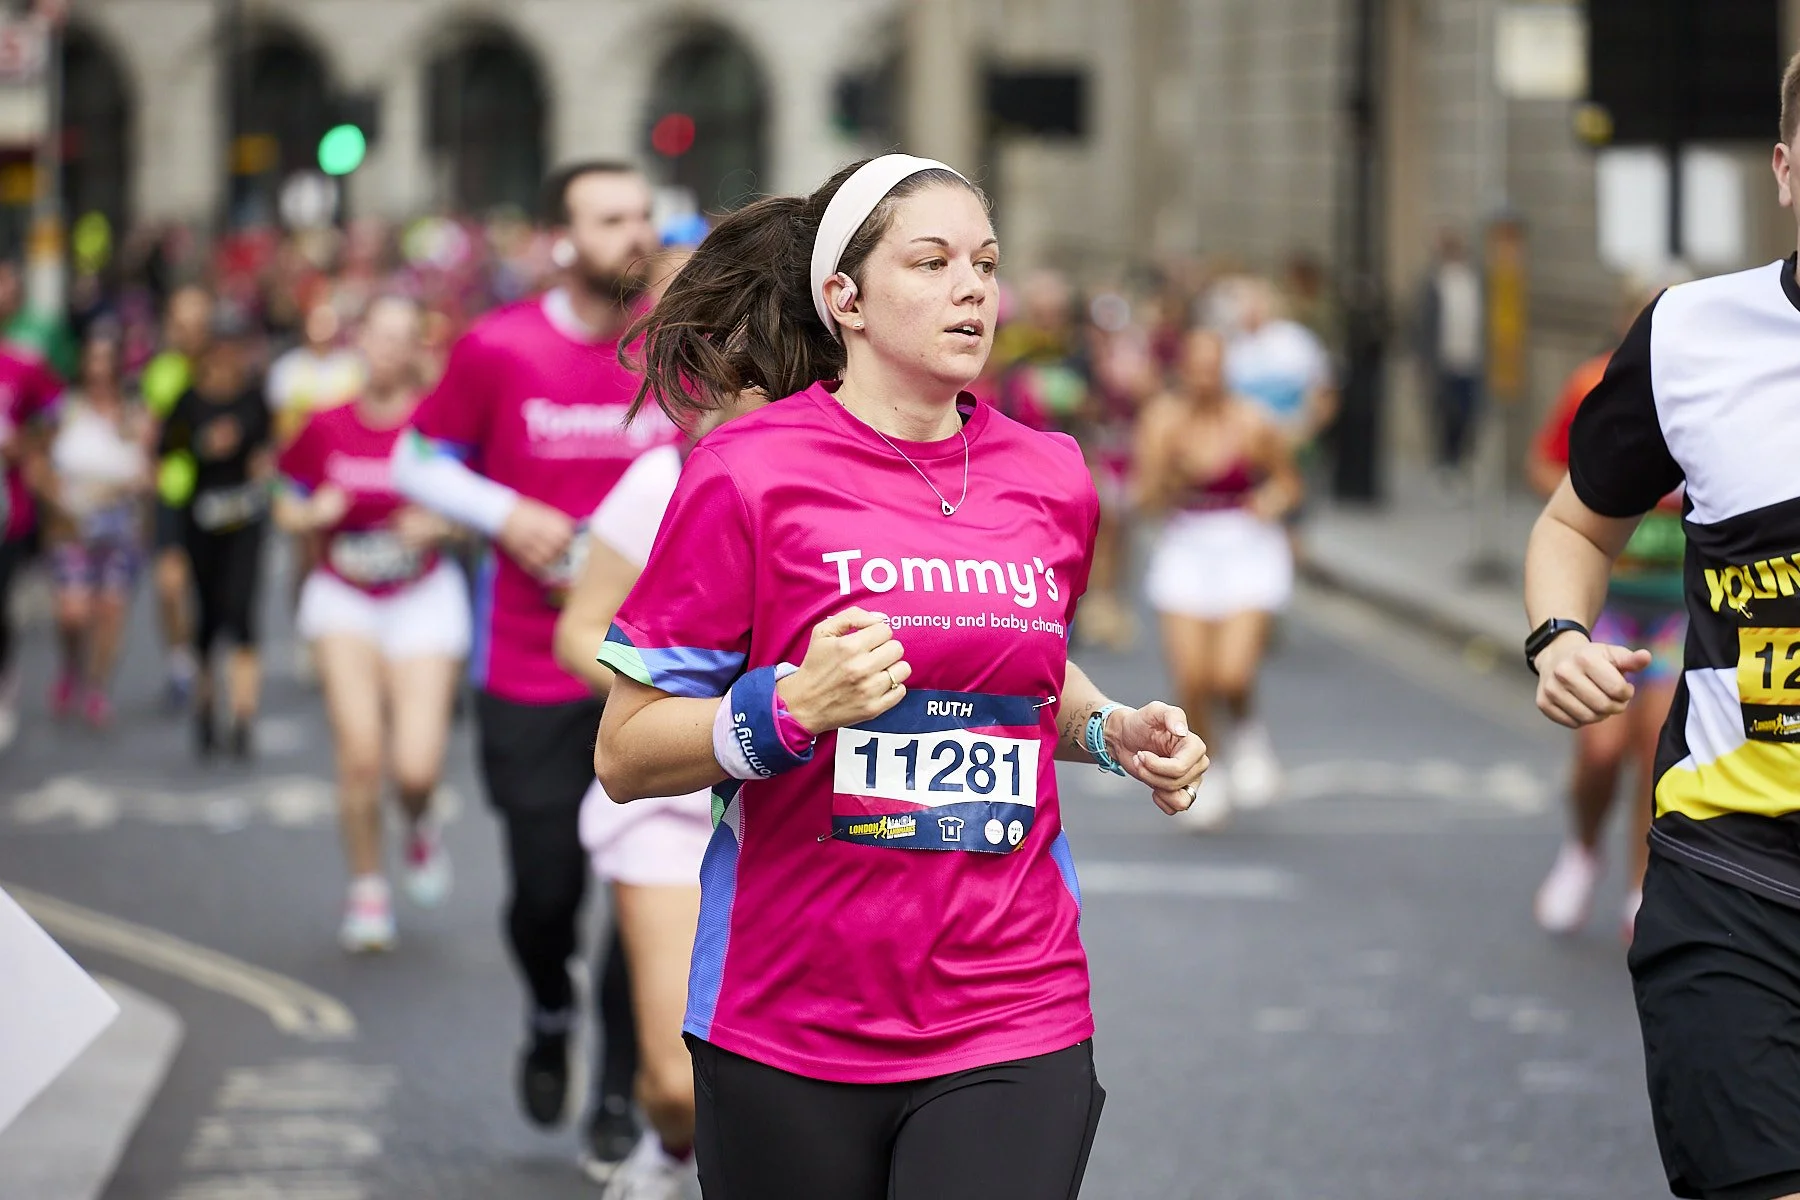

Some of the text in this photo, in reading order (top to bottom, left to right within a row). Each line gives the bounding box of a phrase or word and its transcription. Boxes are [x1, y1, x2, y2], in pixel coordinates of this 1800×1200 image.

[822, 549, 1059, 608] Tommy's
[955, 612, 986, 628] and
[990, 613, 1029, 633] baby
[1031, 618, 1065, 639] charity
[927, 700, 974, 718] RUTH
[734, 712, 777, 778] ommy's
[854, 737, 1021, 796] 11281
[849, 822, 879, 835] LONDON
